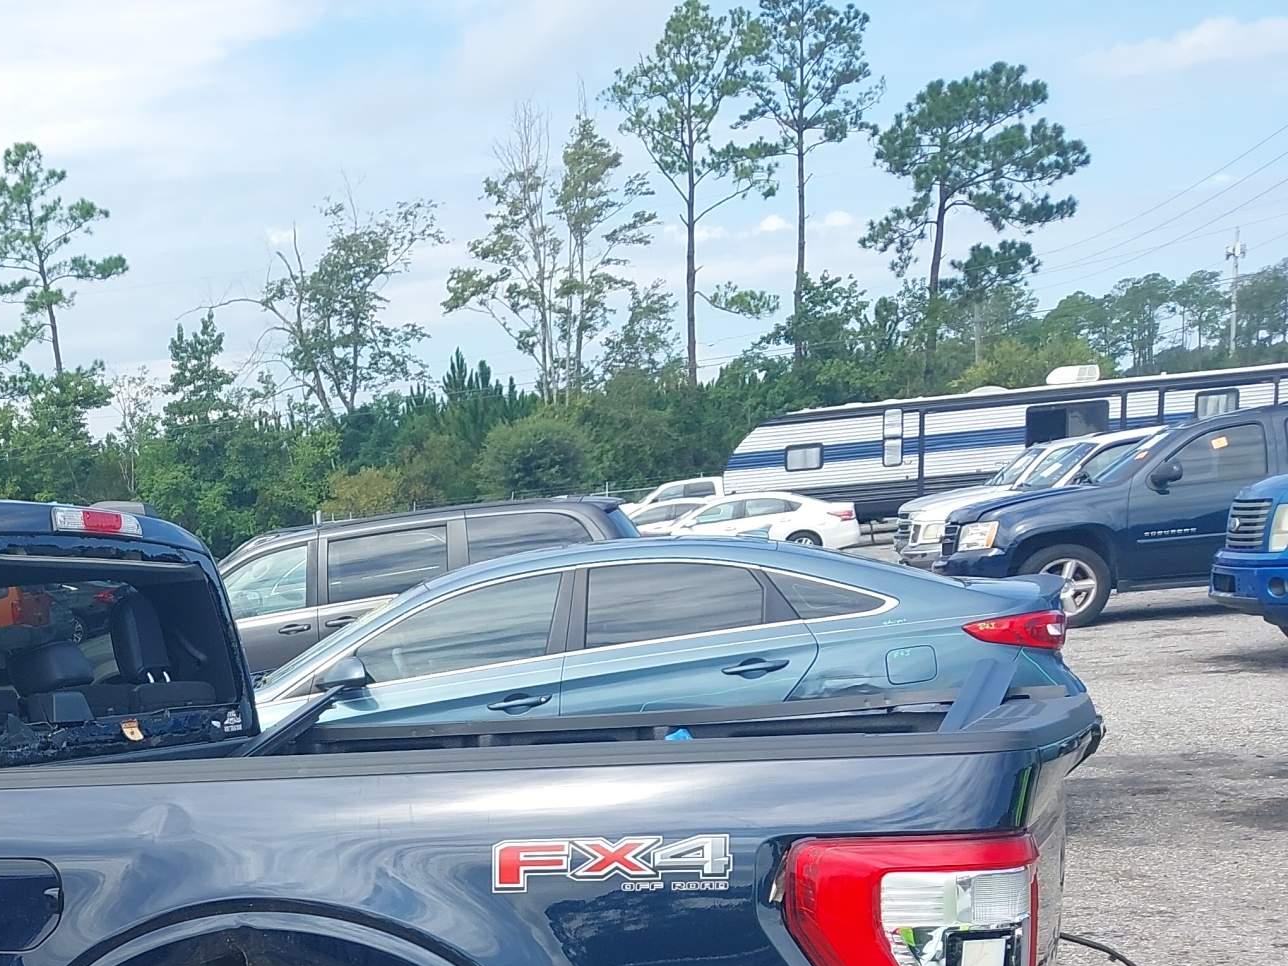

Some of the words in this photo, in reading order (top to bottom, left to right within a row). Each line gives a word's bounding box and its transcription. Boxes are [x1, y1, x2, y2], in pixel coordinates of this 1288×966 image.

[492, 833, 734, 894] FX4
[621, 881, 664, 891] OFF
[671, 881, 729, 891] ROAD
